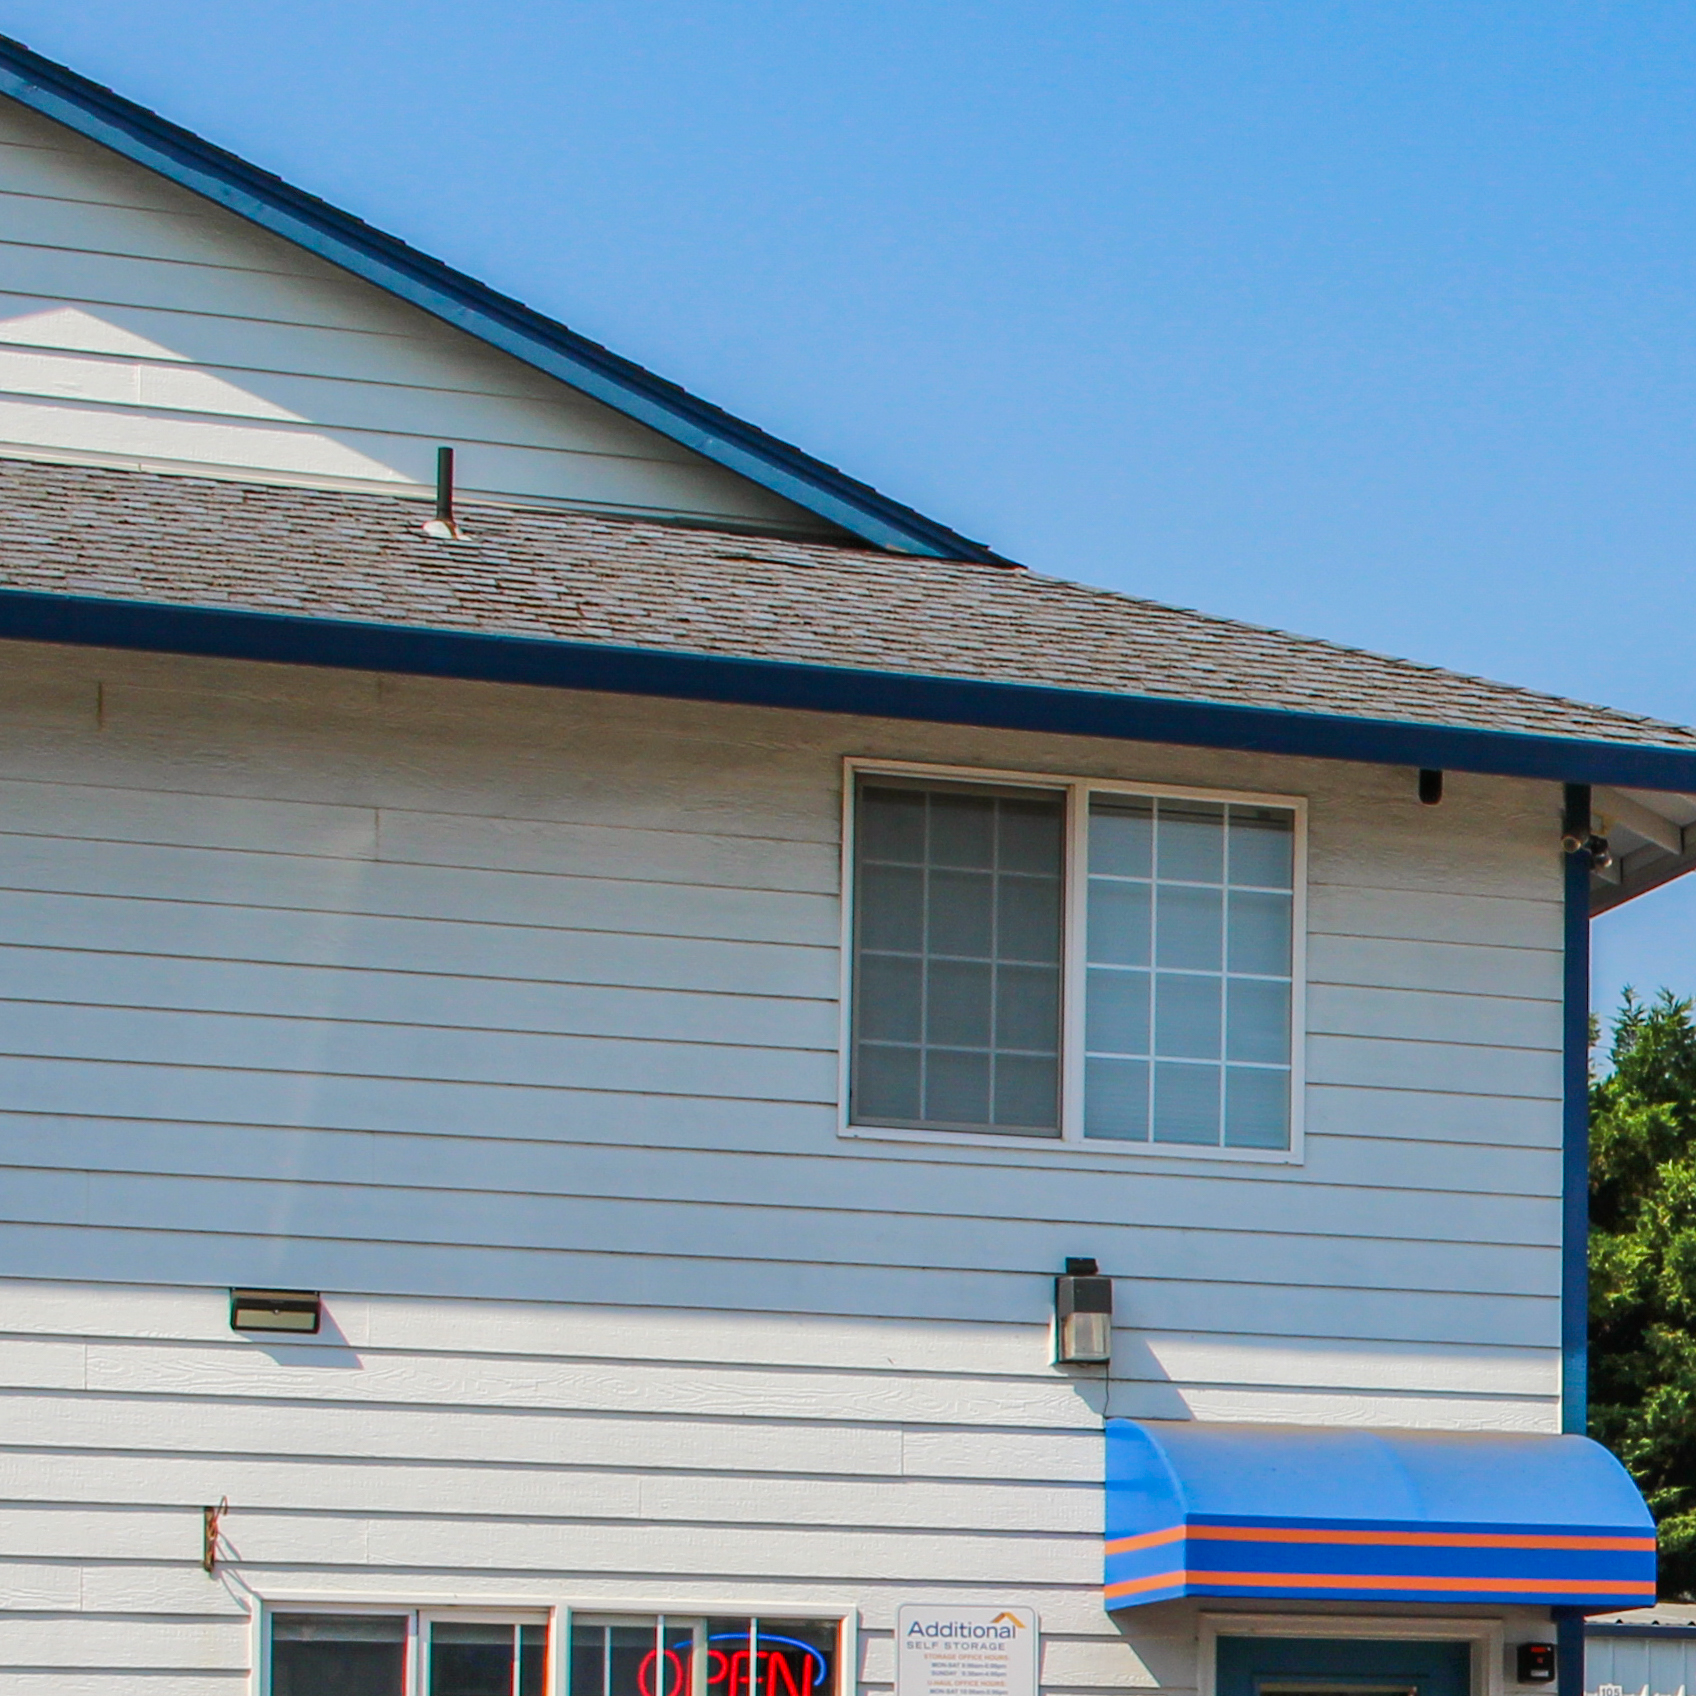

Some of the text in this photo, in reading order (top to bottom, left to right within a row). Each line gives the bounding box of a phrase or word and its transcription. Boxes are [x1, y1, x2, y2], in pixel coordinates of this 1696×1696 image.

[907, 1621, 1016, 1639] Additional
[906, 1641, 1006, 1651] SELF STORAGE
